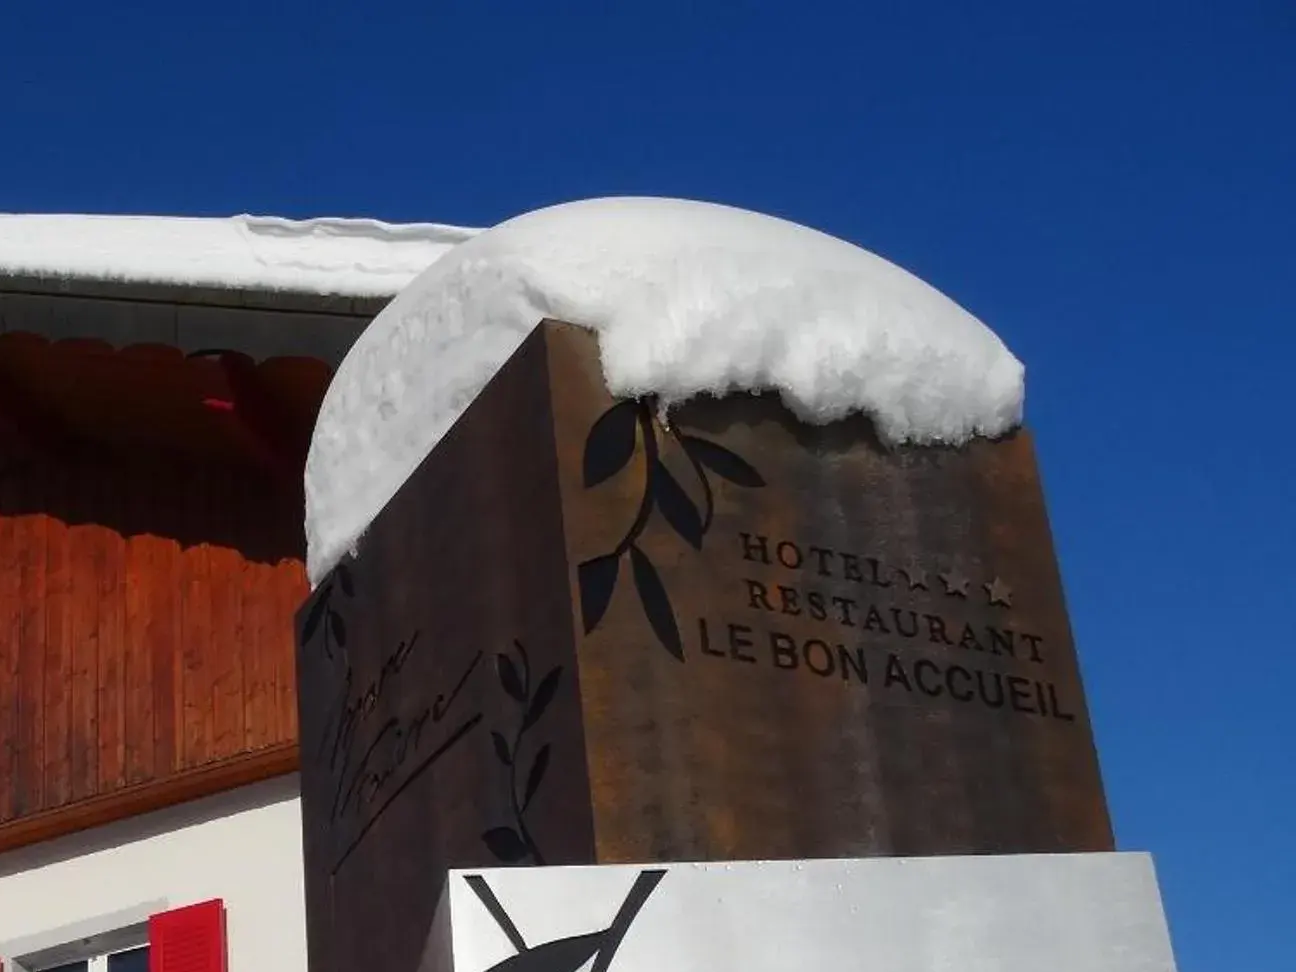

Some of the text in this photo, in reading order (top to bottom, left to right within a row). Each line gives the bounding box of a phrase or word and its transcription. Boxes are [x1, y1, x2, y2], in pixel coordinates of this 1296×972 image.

[738, 531, 892, 589] HOTEL
[742, 578, 1046, 664] RESTAURANT
[698, 617, 1076, 723] LE BON ACCUEIL
